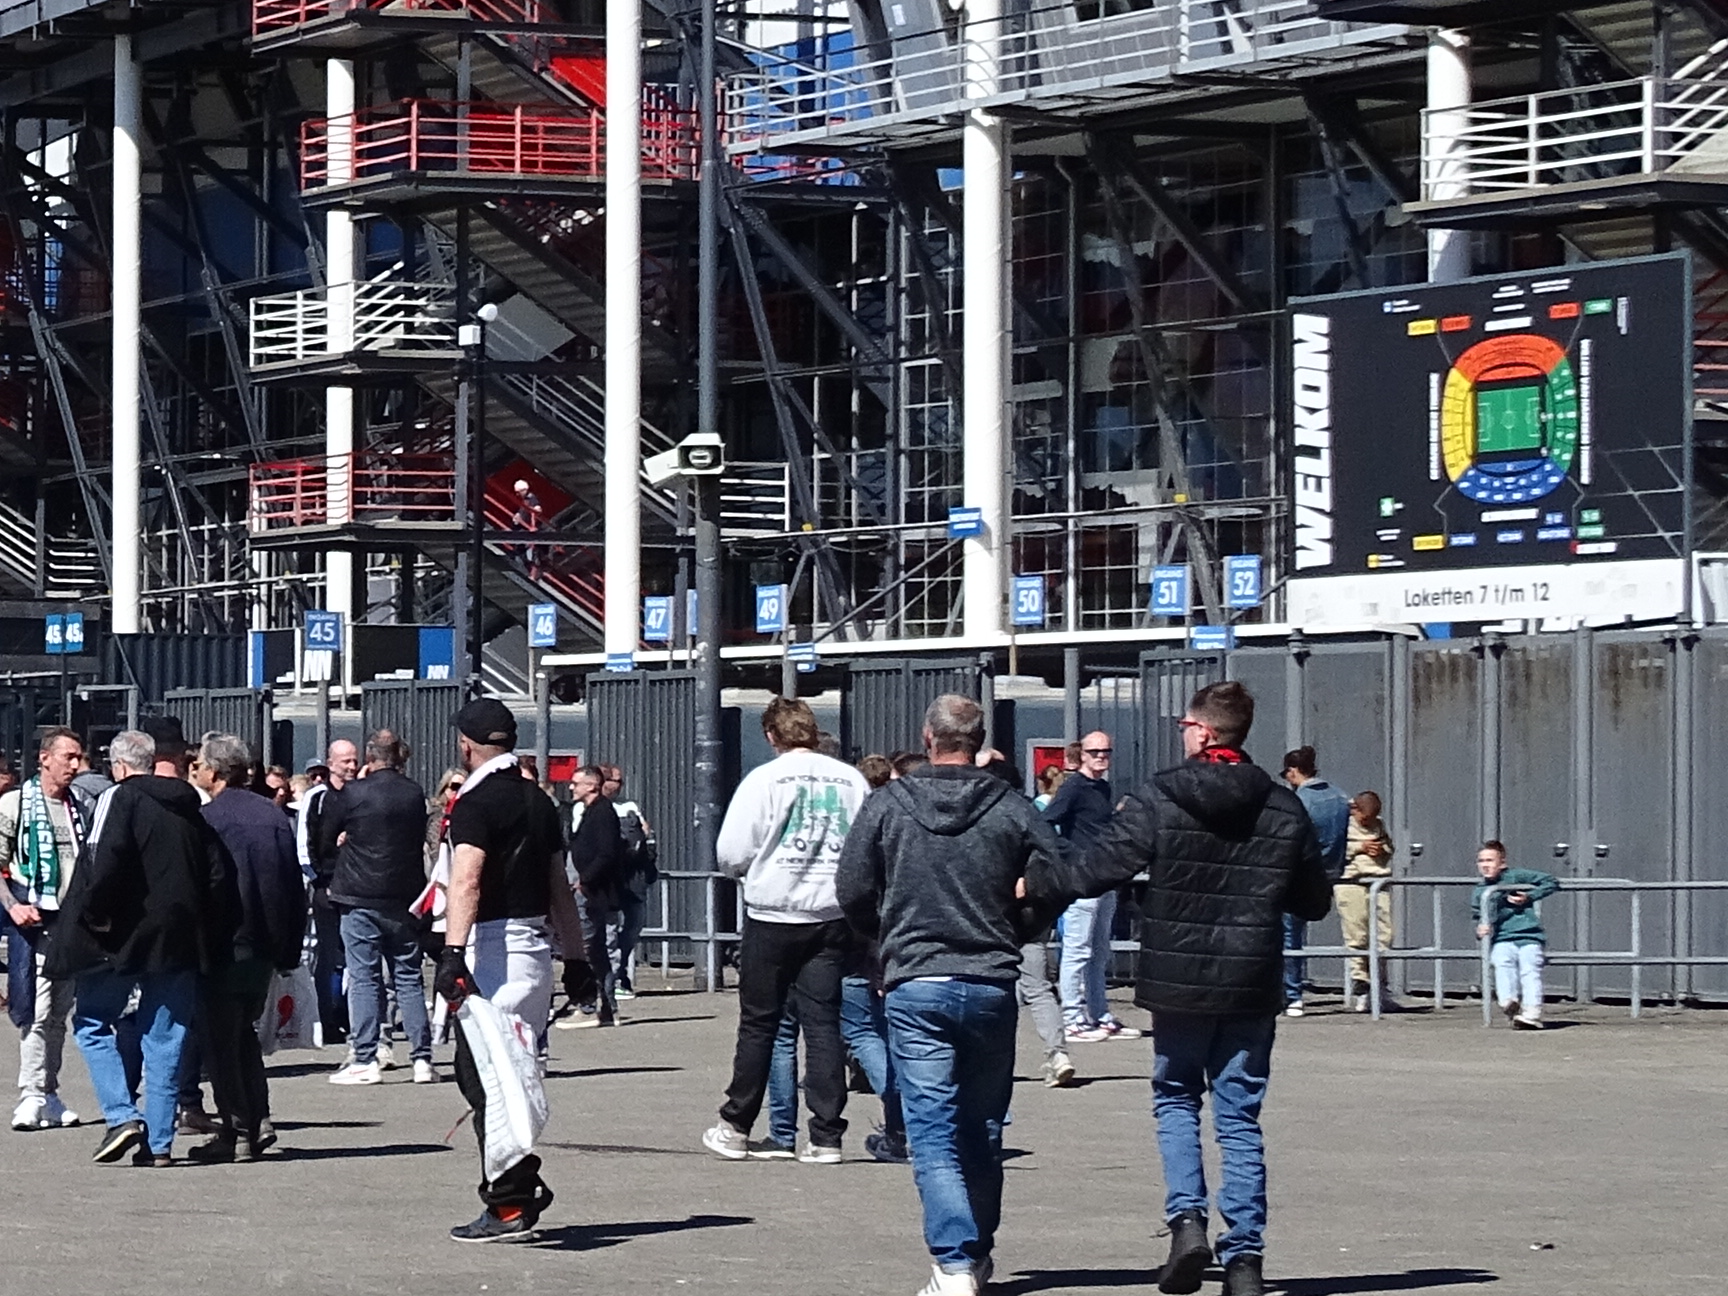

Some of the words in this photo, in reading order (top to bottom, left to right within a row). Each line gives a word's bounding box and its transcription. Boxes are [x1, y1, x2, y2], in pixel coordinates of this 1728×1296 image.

[1292, 312, 1332, 571] WELKOM
[1158, 581, 1178, 604] 51
[1233, 571, 1255, 596] 52
[1404, 585, 1472, 608] Loketten
[1480, 585, 1488, 603] 7
[1494, 584, 1525, 603] t/m
[1532, 582, 1550, 600] 12
[758, 598, 779, 620] 49
[1018, 590, 1039, 613] 50
[535, 615, 553, 636] 46
[646, 609, 666, 629] 47
[309, 622, 335, 642] 45
